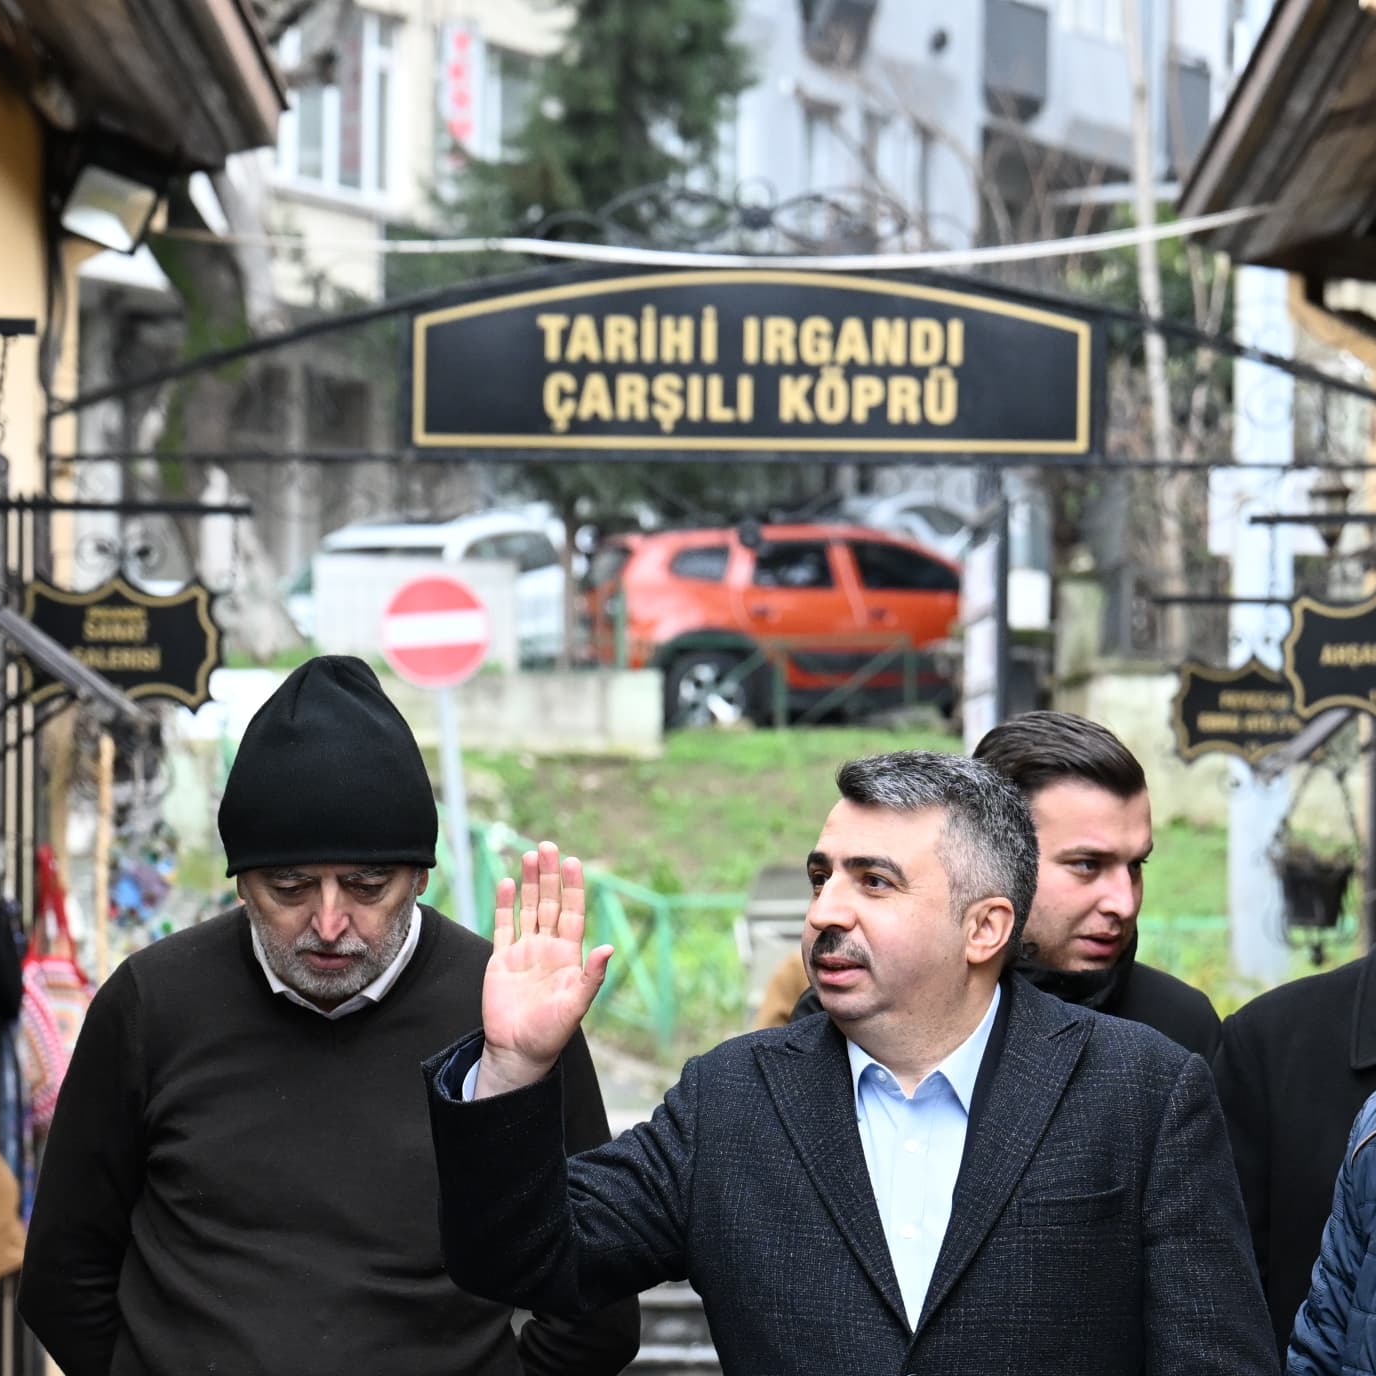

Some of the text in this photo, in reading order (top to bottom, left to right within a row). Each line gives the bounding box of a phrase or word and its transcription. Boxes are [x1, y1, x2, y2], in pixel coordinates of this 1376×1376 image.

[535, 303, 965, 368] TARİHİ IRGANDI
[541, 365, 959, 433] ÇARŞILI KÖPRÜ
